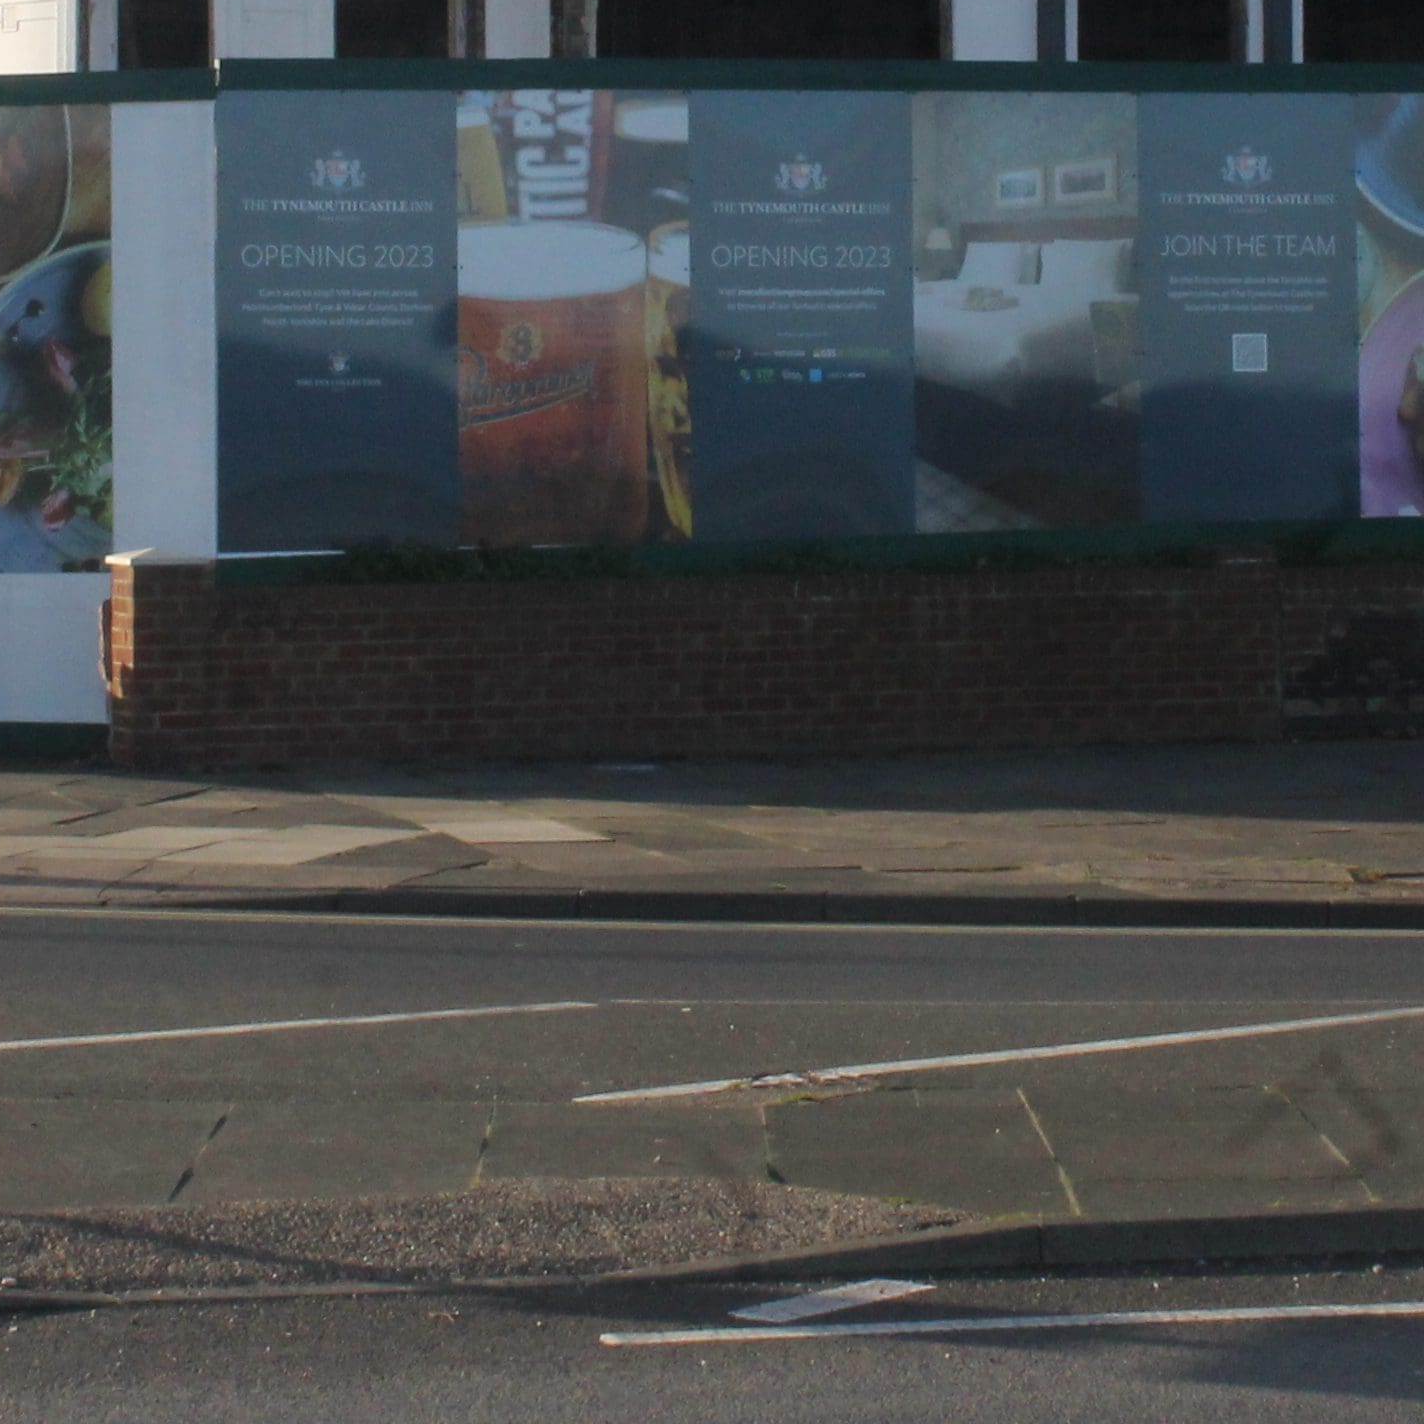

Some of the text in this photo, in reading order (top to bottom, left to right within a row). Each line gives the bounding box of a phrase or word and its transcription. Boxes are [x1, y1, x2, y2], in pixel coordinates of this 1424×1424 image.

[243, 199, 434, 212] THE TYNEMOUTH CASTLE INN
[739, 201, 820, 214] TYNEMOUTH
[822, 202, 864, 214] CASTLE
[1187, 192, 1265, 205] TYNEMOUTH
[1267, 192, 1311, 205] CASTLE
[1159, 233, 1337, 258] JOIN THE TEAM
[240, 244, 435, 269] OPENING 2023
[710, 243, 892, 269] OPENING 2023
